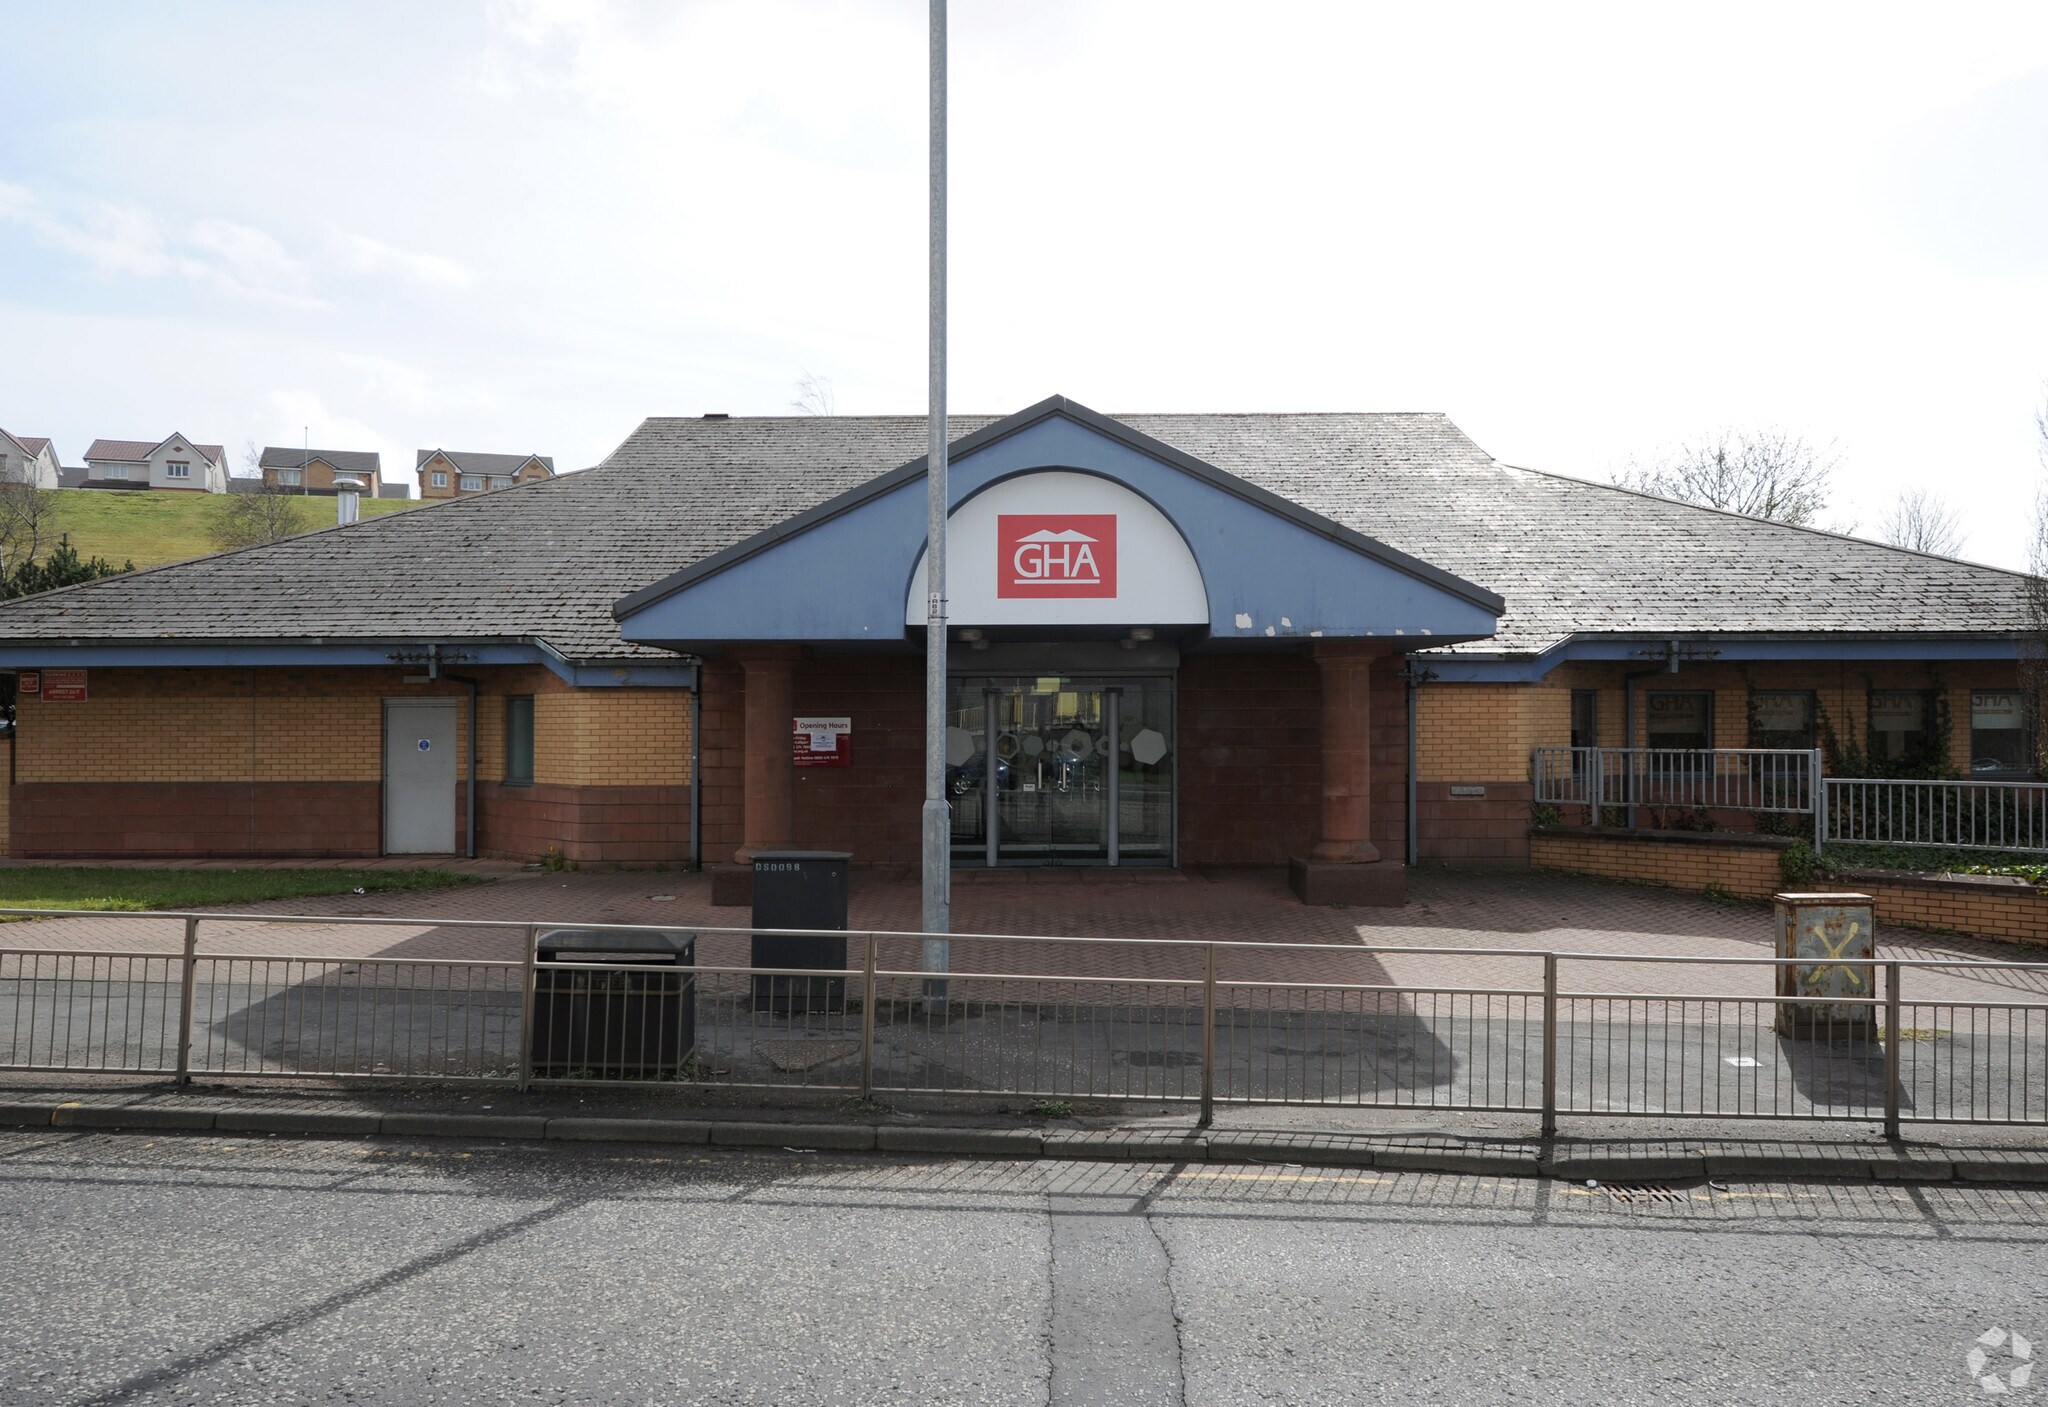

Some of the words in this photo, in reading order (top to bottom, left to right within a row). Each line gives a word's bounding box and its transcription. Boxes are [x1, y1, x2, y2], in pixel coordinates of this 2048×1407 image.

[1013, 543, 1100, 578] GHA
[1649, 696, 1694, 711] GHA
[800, 722, 827, 730] Opening
